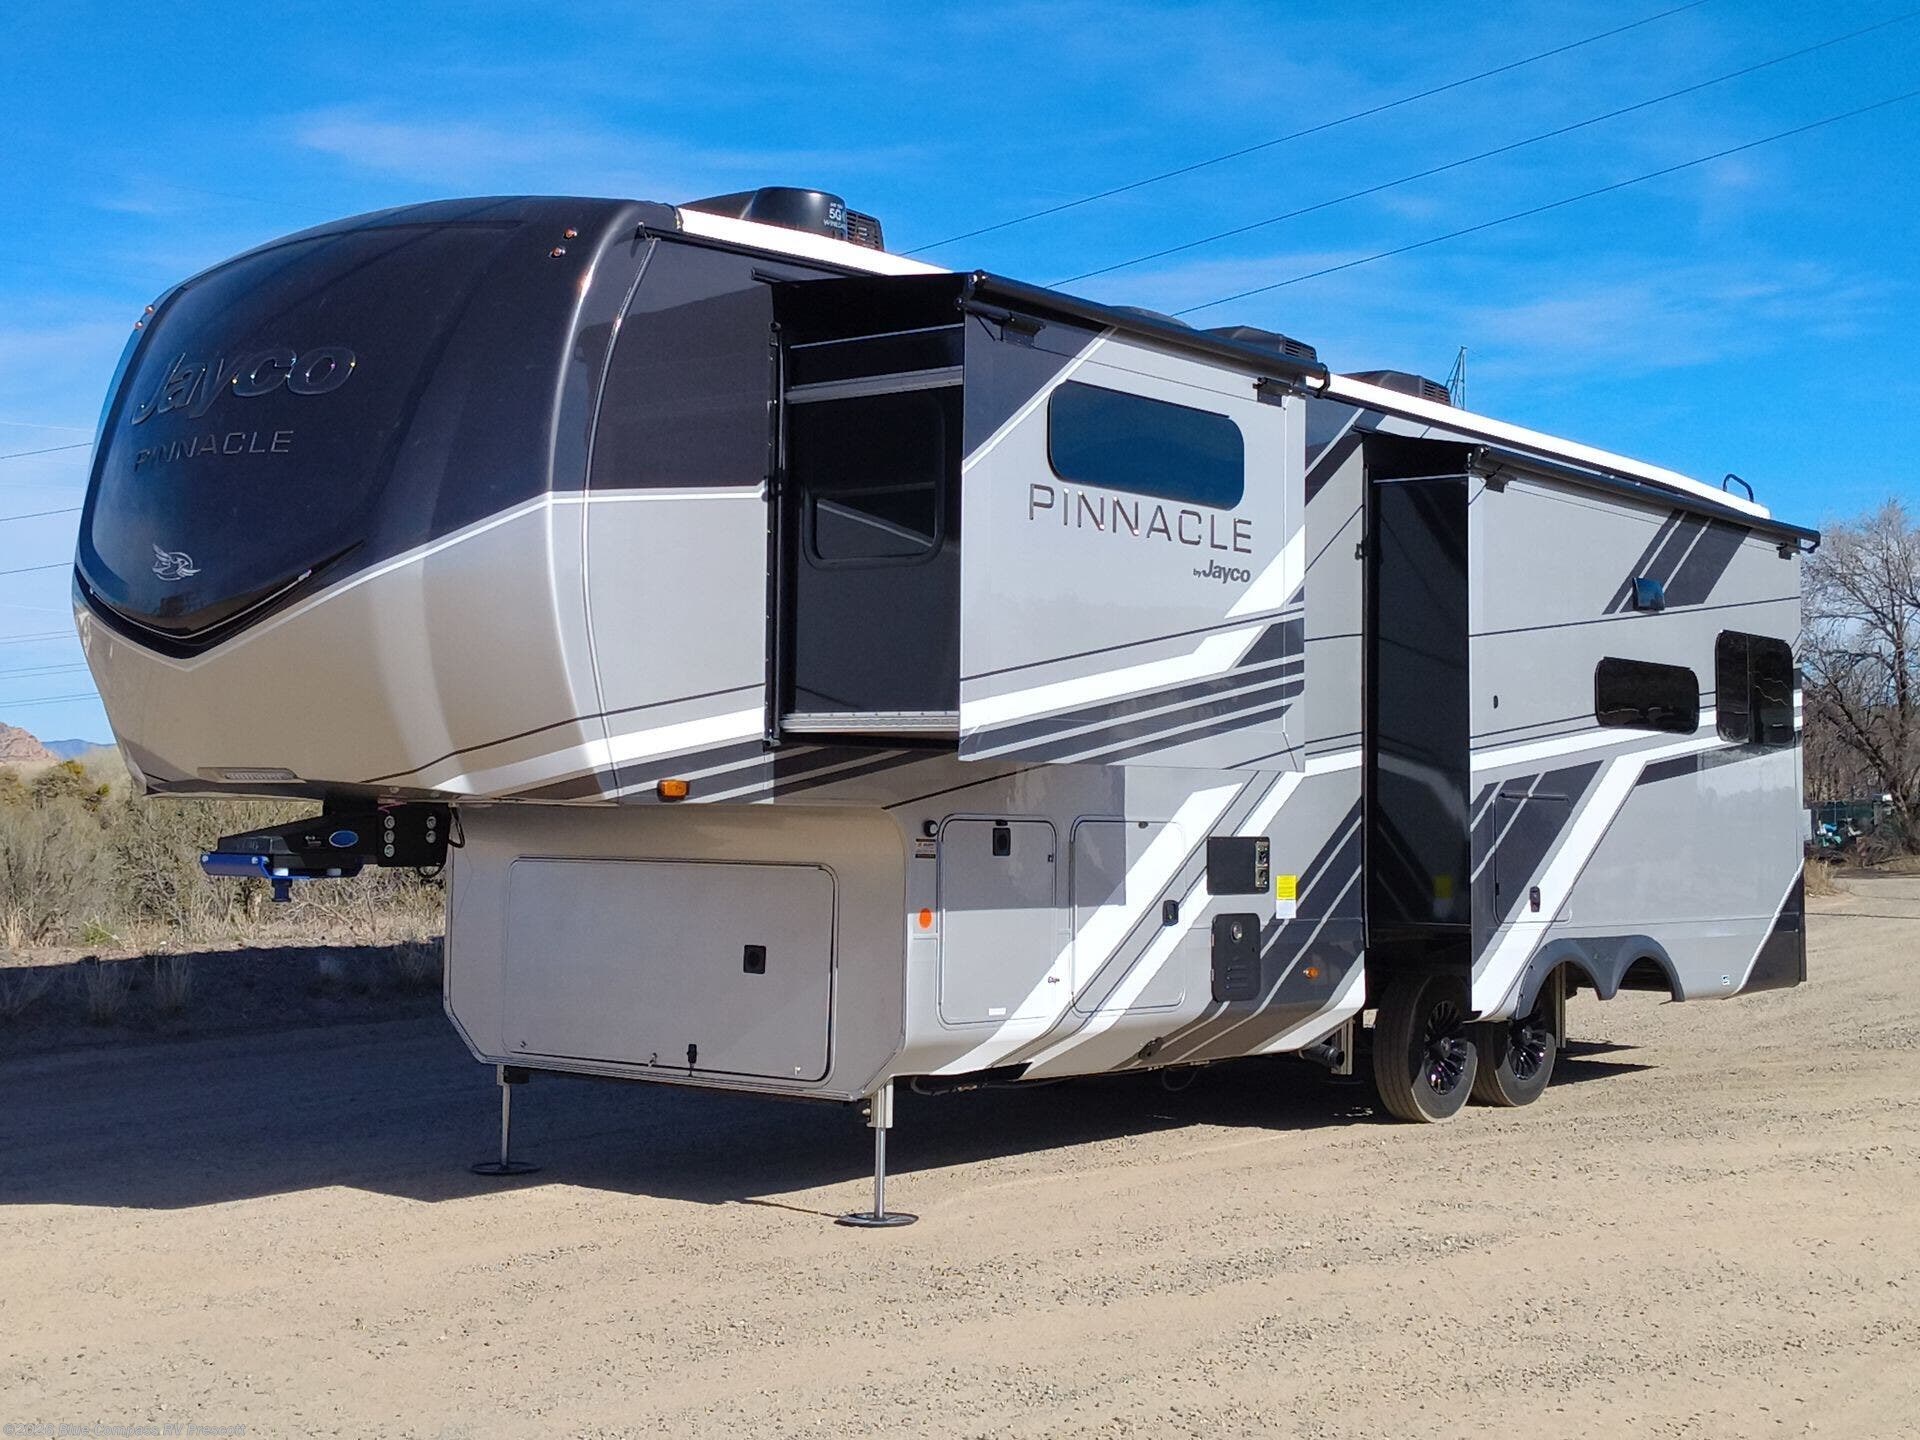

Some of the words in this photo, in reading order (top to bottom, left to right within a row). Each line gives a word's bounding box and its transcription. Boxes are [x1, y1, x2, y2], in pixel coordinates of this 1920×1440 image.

[829, 208, 842, 221] 5G
[131, 346, 355, 425] Jayco
[134, 430, 295, 472] PINNACLE
[1028, 483, 1253, 554] PINNACLE
[1193, 567, 1202, 579] by
[1202, 559, 1251, 584] Jayco
